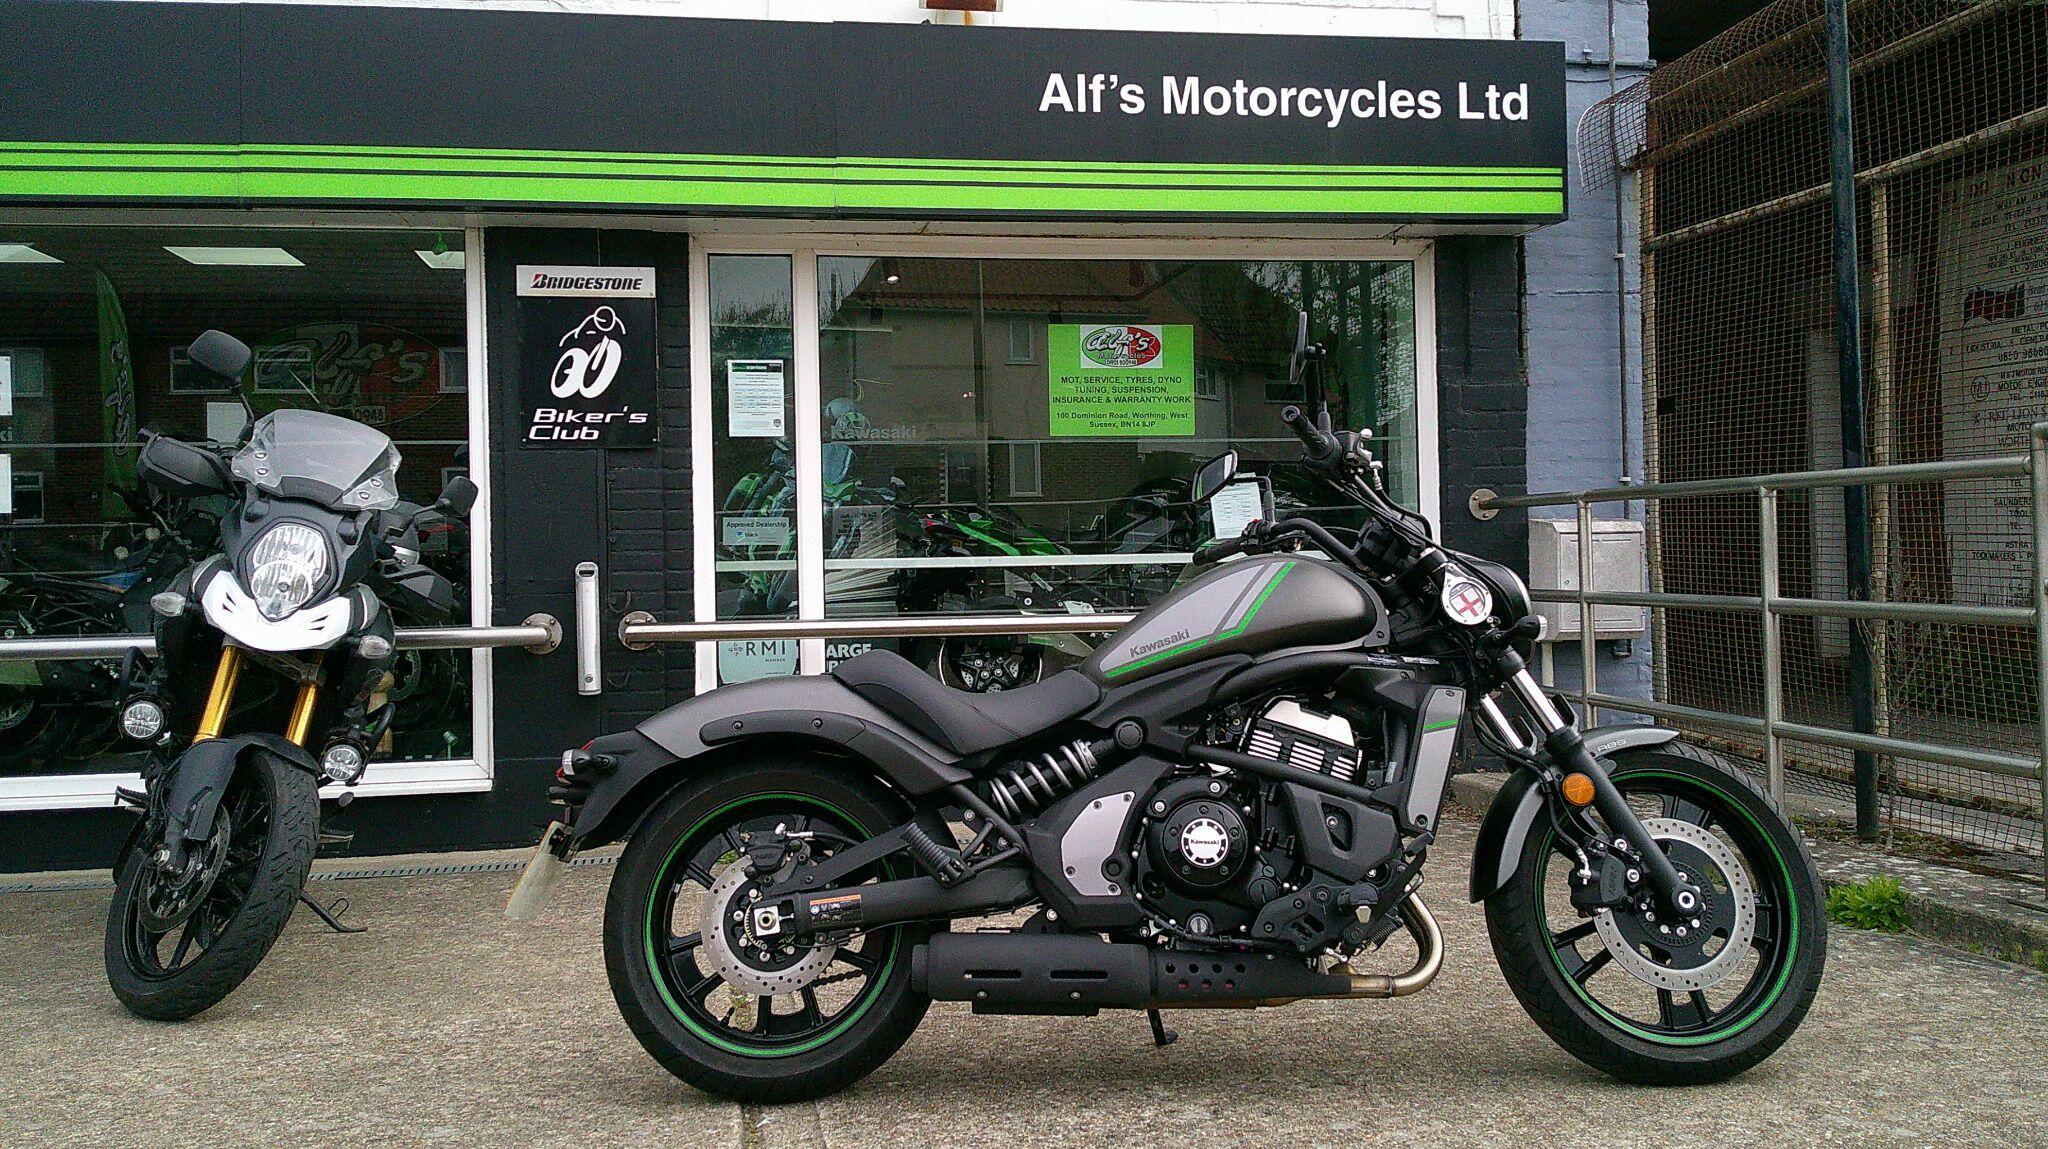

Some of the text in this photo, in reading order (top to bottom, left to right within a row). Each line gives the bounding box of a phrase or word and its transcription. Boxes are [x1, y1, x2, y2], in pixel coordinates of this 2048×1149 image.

[1039, 73, 1529, 128] Alf's Motorcycles Ltd
[530, 273, 644, 291] BRIDGESTONE
[1060, 376, 1182, 385] MOT, SERVICE, TYRES, DYNO
[1075, 386, 1169, 394] TUNING, SUSPENSION,
[1052, 396, 1192, 404] INSURANCE & WARRANTY WORK
[532, 405, 649, 424] Biker's
[1109, 412, 1131, 420] Road,
[1132, 412, 1168, 421] Worthing,
[1089, 421, 1119, 429] Sussex,
[2008, 421, 2032, 432] MOTO
[528, 425, 600, 441] Club
[830, 425, 917, 440] Kawasaki
[726, 521, 787, 529] Approved Dealership
[745, 640, 786, 657] RMI
[1128, 628, 1192, 658] Kawasaki
[1597, 738, 1627, 752] ABS
